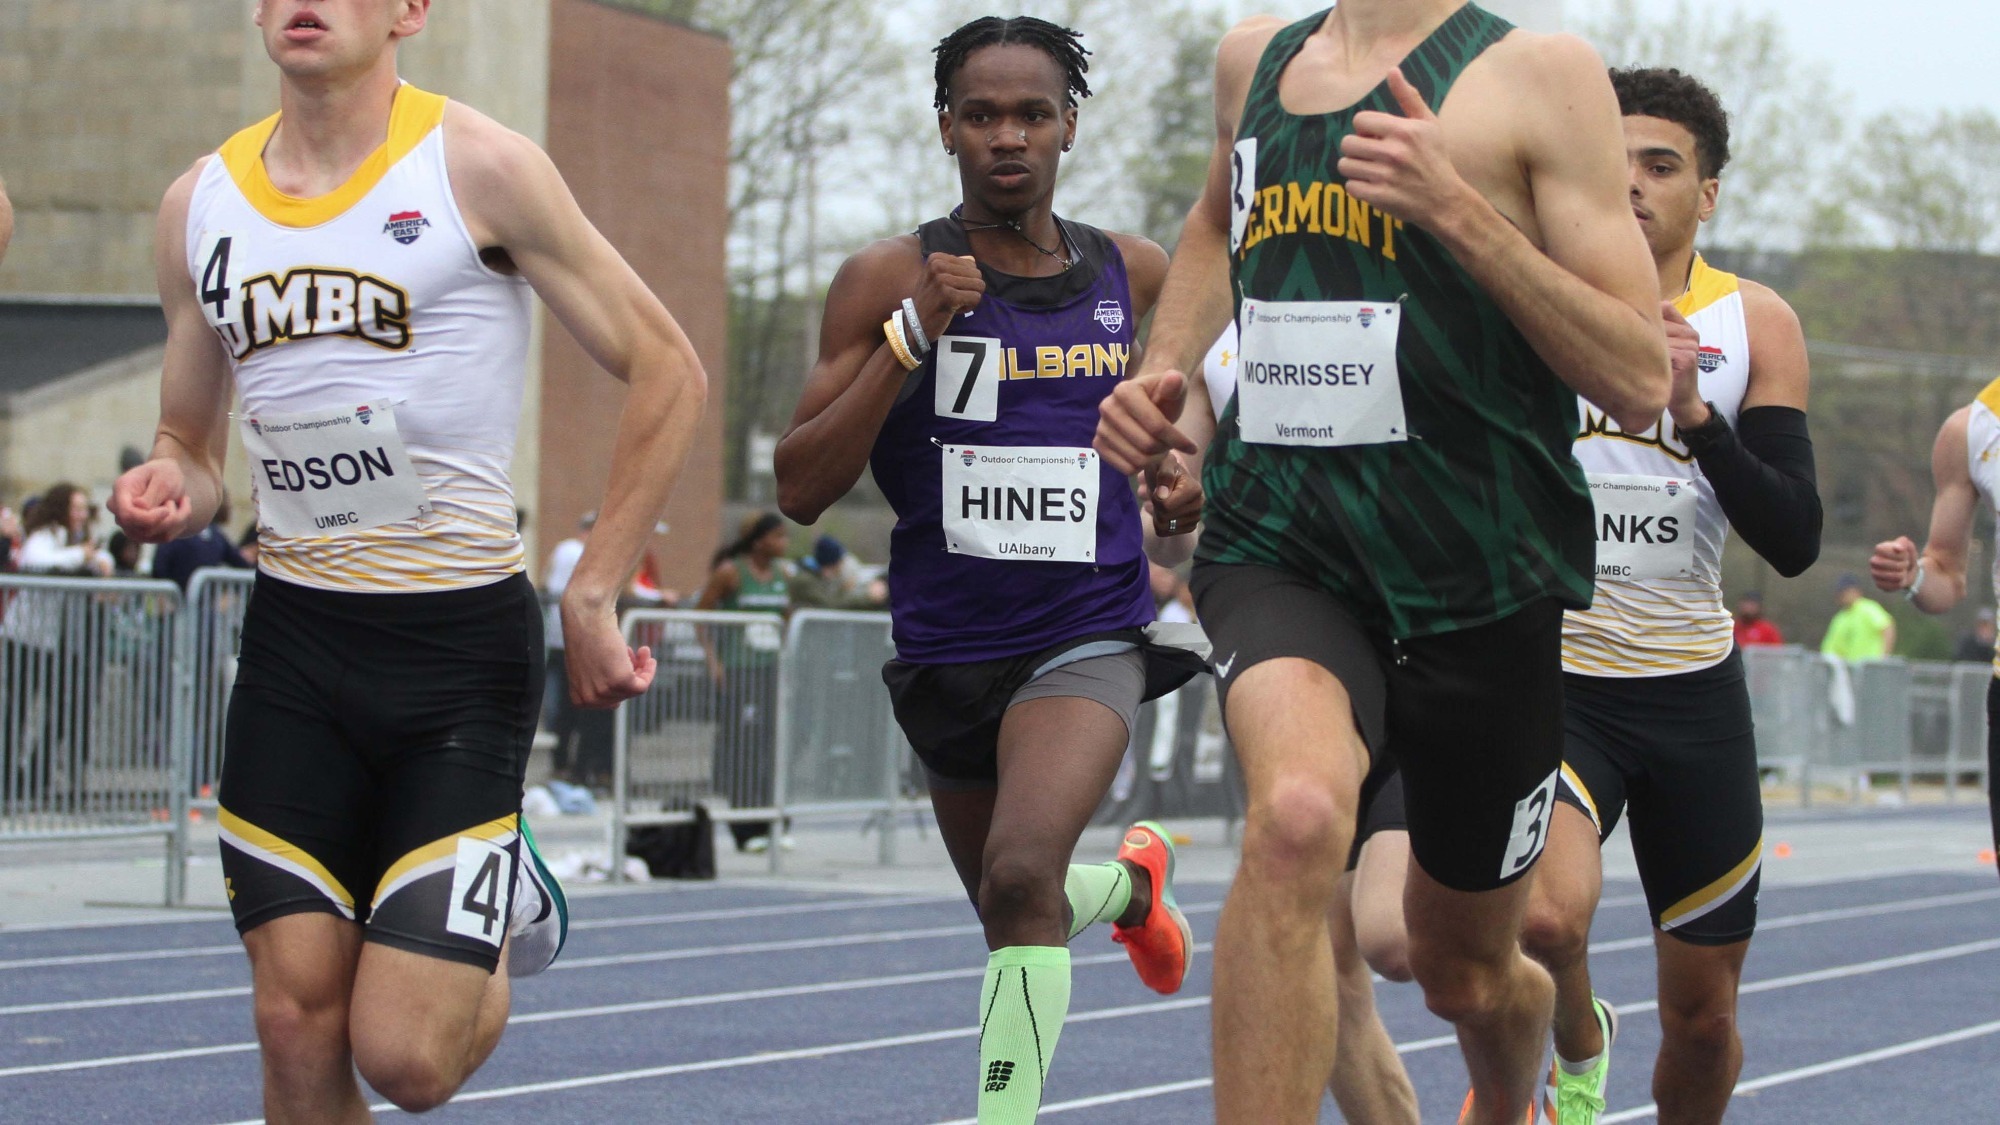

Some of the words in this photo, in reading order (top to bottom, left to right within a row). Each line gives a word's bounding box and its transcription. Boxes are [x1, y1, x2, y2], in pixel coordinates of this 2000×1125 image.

[382, 217, 431, 234] AMERICA
[1240, 181, 1404, 261] ERMONT
[393, 226, 420, 237] EAST
[201, 236, 232, 319] 4
[215, 266, 410, 363] UMBC
[1284, 312, 1352, 325] Championship
[1698, 352, 1728, 364] MERICA
[950, 340, 987, 414] 7
[1244, 360, 1375, 386] MORRISSEY
[263, 424, 292, 433] Outdoor
[292, 415, 352, 431] Championship
[1275, 423, 1334, 439] Vermont
[261, 446, 395, 492] EDSON
[981, 455, 1015, 464] Outdoor
[1017, 455, 1076, 466] Championship
[1602, 482, 1661, 494] Championship
[961, 485, 1087, 523] HINES
[314, 511, 360, 530] UMBC
[1594, 513, 1679, 544] NKS
[998, 542, 1056, 557] UAlbany
[1514, 786, 1549, 869] 3
[461, 851, 501, 937] 4
[985, 1081, 1008, 1093] cep
